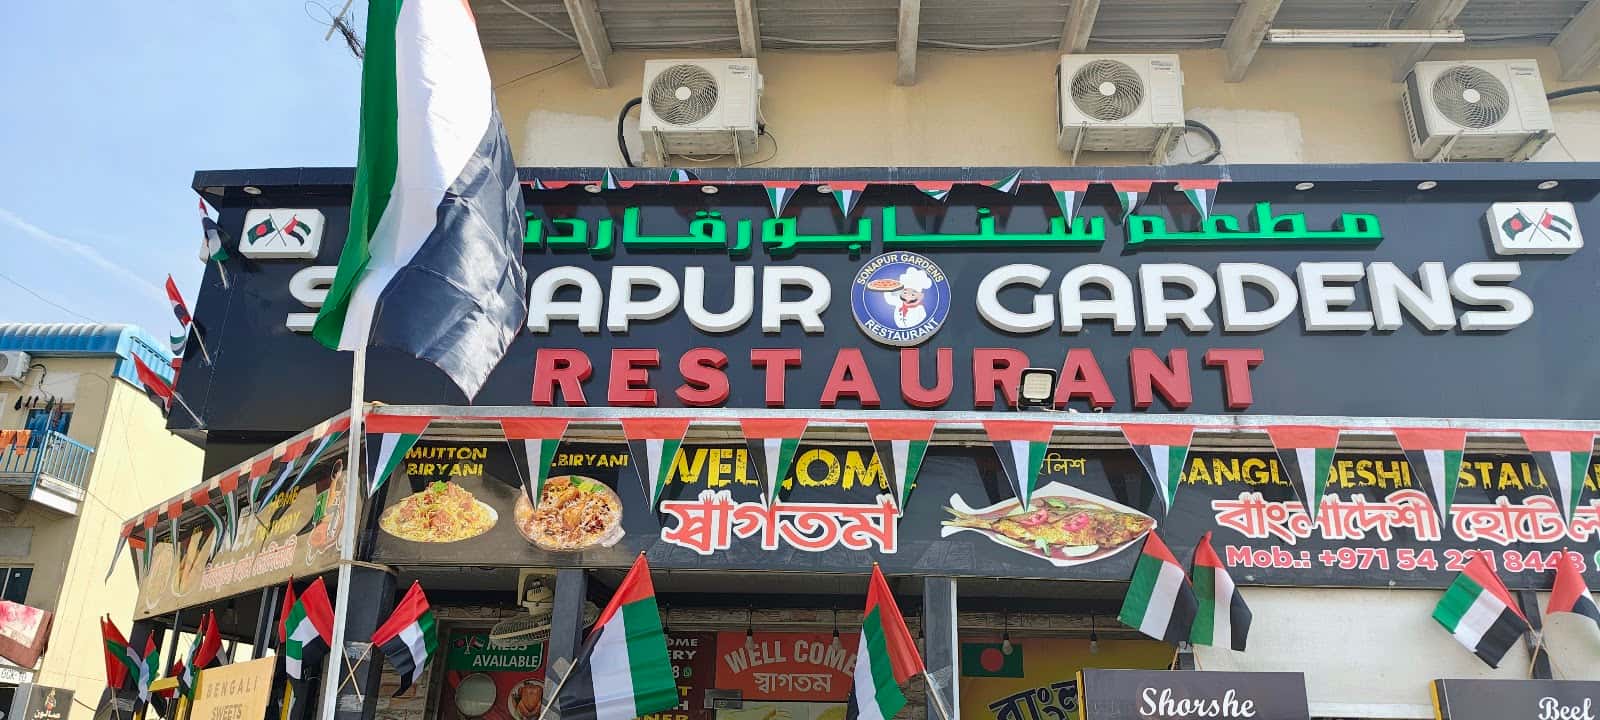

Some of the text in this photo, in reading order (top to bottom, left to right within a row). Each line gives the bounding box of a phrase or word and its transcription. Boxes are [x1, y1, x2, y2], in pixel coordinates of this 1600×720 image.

[1126, 202, 1384, 249] مطعم
[857, 254, 944, 285] SONAPUR GARDENS
[286, 262, 1534, 334] SAPUR GARDENS
[865, 317, 940, 341] RESTAURANT
[531, 347, 1265, 409] RESTAURANT
[404, 447, 487, 460] MUTTON
[406, 463, 483, 477] BIRYANI
[661, 490, 904, 556] স্বাগতম
[1226, 546, 1312, 568] Mob.:
[1319, 547, 1390, 569] +971
[1397, 549, 1438, 570] 54
[473, 655, 540, 668] AVAILABLE
[206, 675, 259, 698] BENGALI
[752, 672, 833, 694] স্বাগতম
[1139, 687, 1257, 718] Shorshe
